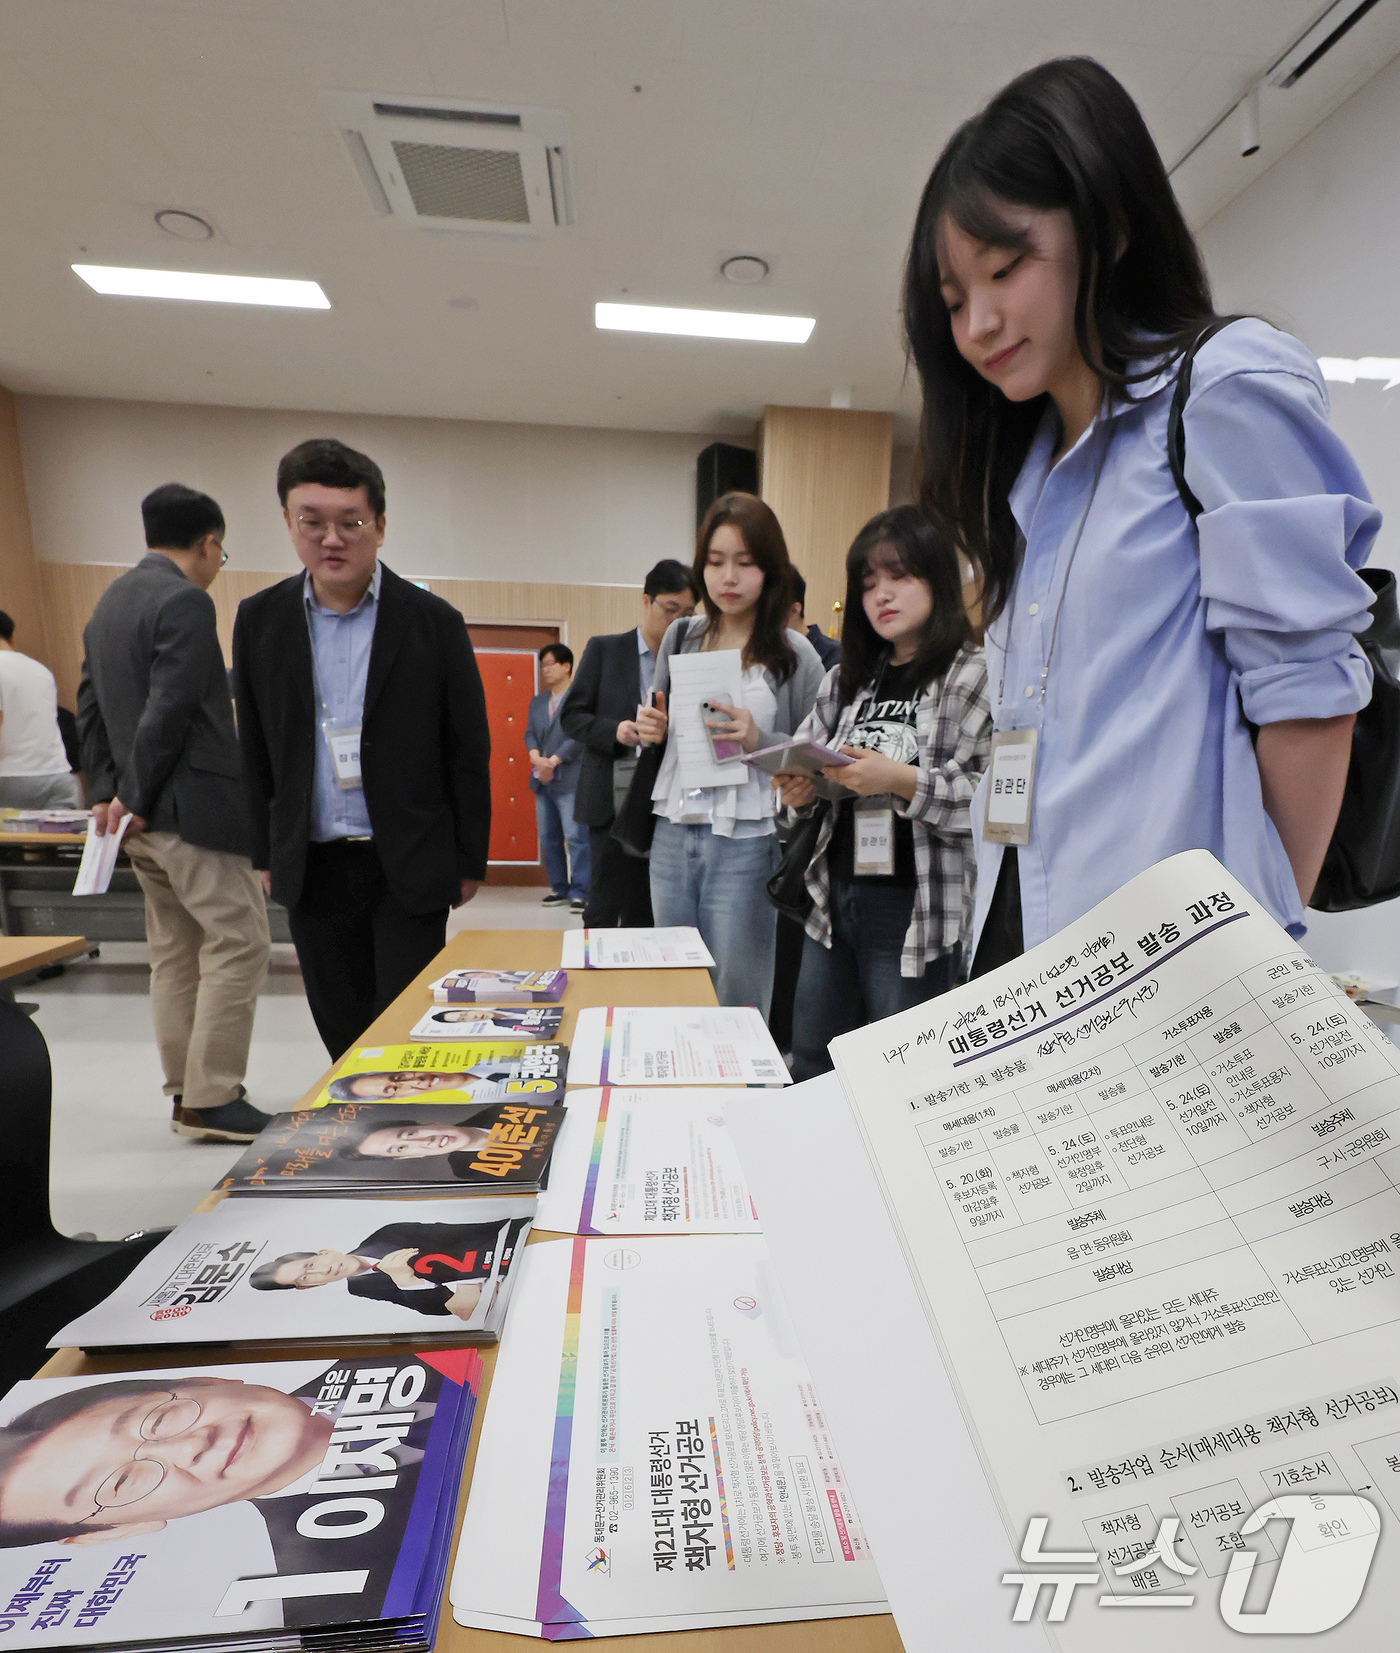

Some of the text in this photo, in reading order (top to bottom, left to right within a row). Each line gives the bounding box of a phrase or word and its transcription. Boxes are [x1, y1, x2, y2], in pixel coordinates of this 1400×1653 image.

[947, 891, 1236, 1056] 대통령선거 선거공보 발송 과정
[1267, 963, 1291, 980] 군인
[1291, 959, 1304, 971] 등
[1272, 984, 1316, 1009] 발송기한
[1161, 1005, 1214, 1040] 거소투표자용
[1212, 1021, 1243, 1044] 발송물
[1290, 1033, 1305, 1045] 5.
[1307, 1013, 1348, 1037] 24.(토)
[1308, 1029, 1354, 1056] 선거일전
[1149, 1053, 1188, 1079] 발송기한
[1217, 1048, 1255, 1074] 거소투표
[1317, 1043, 1367, 1070] 10일까지
[506, 1079, 558, 1094] 5
[910, 1060, 1028, 1111] 1. 발송기한 및 발송물
[1047, 1065, 1102, 1094] 매세대용(2차)
[1225, 1066, 1257, 1087] 안내문
[1234, 1065, 1292, 1101] 거소투표용지
[1098, 1082, 1127, 1101] 발송물
[1166, 1083, 1211, 1111] 5. 24.(토)
[1037, 1103, 1074, 1124] 발송기한
[1178, 1099, 1218, 1124] 선거일전
[1244, 1094, 1276, 1116] 책자형
[1255, 1102, 1297, 1131] 선거공보
[942, 1107, 996, 1132] 매세대용(1차)
[993, 1123, 1021, 1140] 발송물
[1109, 1114, 1156, 1140] 투표안내문
[1186, 1111, 1228, 1137] 10일까지
[1311, 1107, 1356, 1138] 발송주체
[938, 1140, 974, 1159] 발송기한
[1048, 1131, 1096, 1156] 5. 24.(토)
[1118, 1134, 1148, 1153] 전단형
[1127, 1144, 1166, 1166] 선거공보
[1056, 1146, 1102, 1169] 선거인명부
[1067, 1160, 1105, 1181] 확정일후
[945, 1167, 993, 1190] 5. 20.(화)
[1011, 1165, 1040, 1181] 책자형
[1018, 1176, 1053, 1195] 선거공보
[1076, 1174, 1112, 1194] 2일까지
[953, 1181, 998, 1203] 후보자등록
[962, 1195, 999, 1214] 마감일후
[1288, 1191, 1334, 1219] 발송대상
[969, 1209, 1005, 1227] 9일까지
[1066, 1209, 1107, 1231] 발송주체
[170, 1241, 257, 1306] 김문수
[175, 1243, 219, 1280] 대한민국
[412, 1250, 478, 1275] 2
[1093, 1260, 1135, 1283] 발송대상
[1283, 1238, 1391, 1285] 거소투표신고인명부에
[1329, 1260, 1395, 1295] 있는 선거인
[1058, 1287, 1220, 1348] 선거인명부에 올라있는 모든 세대주
[1031, 1290, 1281, 1375] 세대주가 선거인명부에 올라있지 않거나 거소투표신고인인
[1038, 1319, 1247, 1391] 경우에는 그 세대의 다음 순위의 선거인에게 발송
[310, 1368, 351, 1417] 지금은
[740, 1442, 750, 1459] 이유는
[1067, 1384, 1400, 1493] 2. 발송작업 순서(매세대용 책자형 선거공보)
[730, 1470, 740, 1488] 책자형
[743, 1460, 753, 1472] 않은
[760, 1464, 772, 1492] 선거공보는
[1273, 1459, 1332, 1489] 기호순서
[212, 1364, 427, 1618] 1 이재명
[609, 1467, 619, 1521] 02-965-1390
[624, 1468, 632, 1509] 02623
[675, 1419, 717, 1572] 책자형 선거공보
[733, 1489, 744, 1507] 1차로
[745, 1472, 758, 1498] 동봉되지
[594, 1467, 606, 1543] 동대문구선거관리위원회
[648, 1431, 678, 1572] 제21대 대통령선거
[764, 1492, 775, 1510] 공약과
[782, 1503, 793, 1518] 있는
[795, 1461, 825, 1554] 우편물 송달 불능 시 반환 필요
[750, 1499, 765, 1536] 선거공보가
[1100, 1514, 1142, 1536] 책자형
[1189, 1500, 1246, 1529] 선거공보
[737, 1507, 752, 1562] 대통령선거에는
[784, 1519, 798, 1542] 뒷면에
[1216, 1529, 1247, 1553] 조합
[757, 1537, 768, 1561] 여기에
[789, 1543, 801, 1559] 봉투
[73, 1553, 147, 1628] 대한민국
[1130, 1569, 1161, 1590] 배열
[30, 1589, 84, 1630] 진짜
